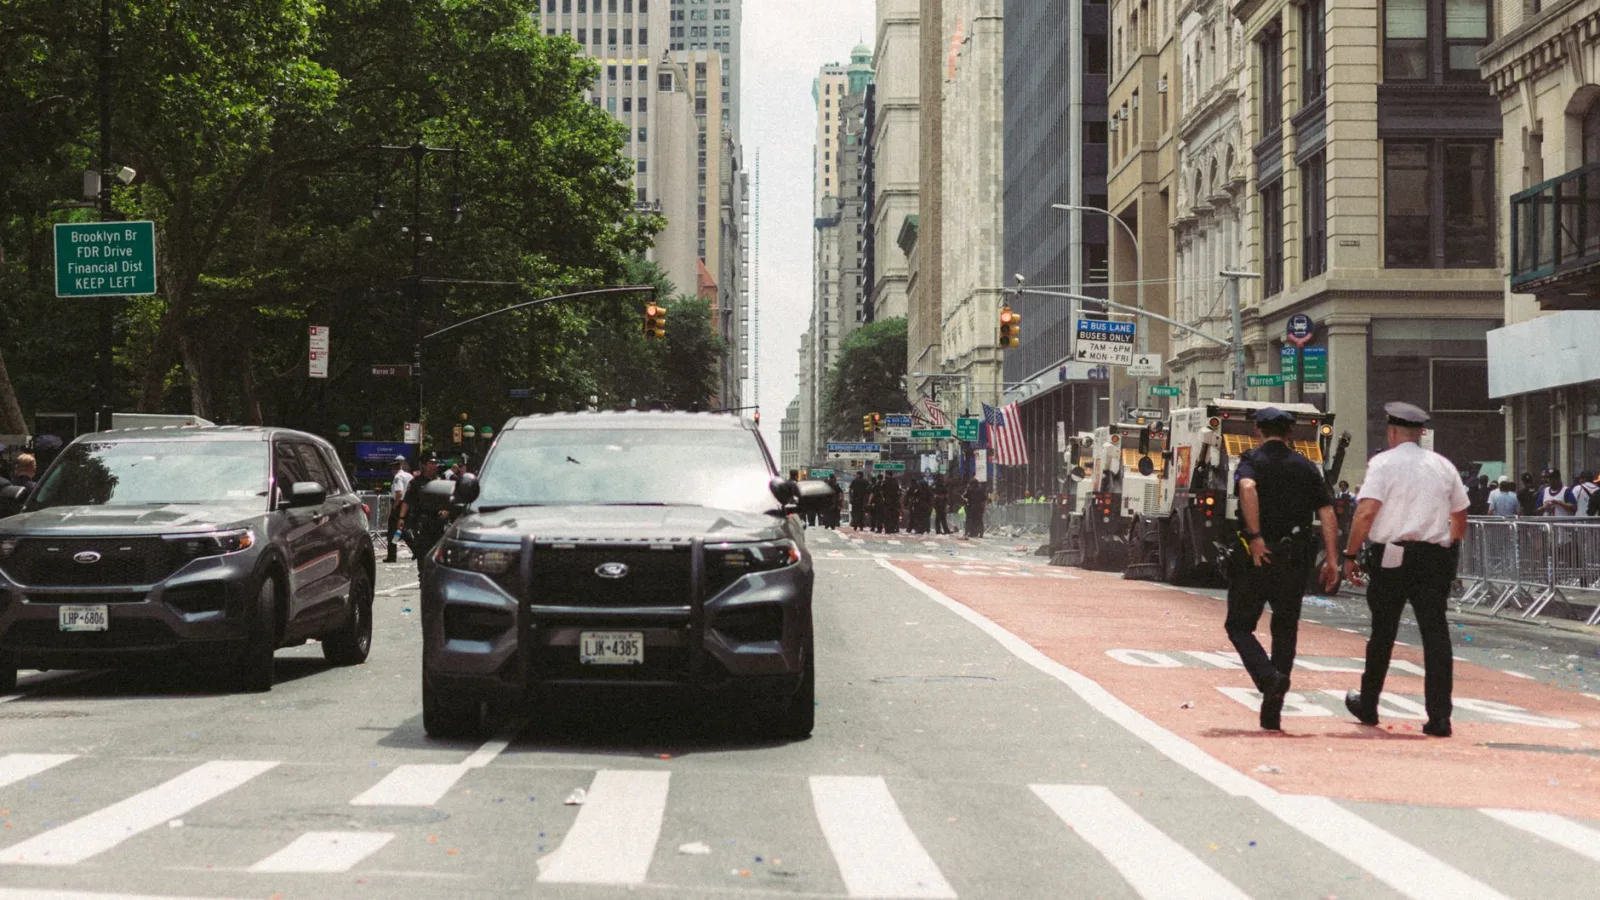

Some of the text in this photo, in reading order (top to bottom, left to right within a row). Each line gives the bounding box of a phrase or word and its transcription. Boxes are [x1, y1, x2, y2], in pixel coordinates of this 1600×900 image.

[71, 229, 138, 244] Brooklyn Br
[77, 245, 132, 258] FDR Drive
[68, 260, 143, 274] Financial Dist
[75, 276, 136, 289] KEEP LEFT
[1090, 322, 1131, 332] BUS LANE
[1080, 331, 1131, 342] BUSES ONLY
[1090, 352, 1107, 360] MON
[1115, 354, 1129, 362] FRI
[1250, 376, 1274, 386] Warren
[1152, 386, 1171, 394] Warren
